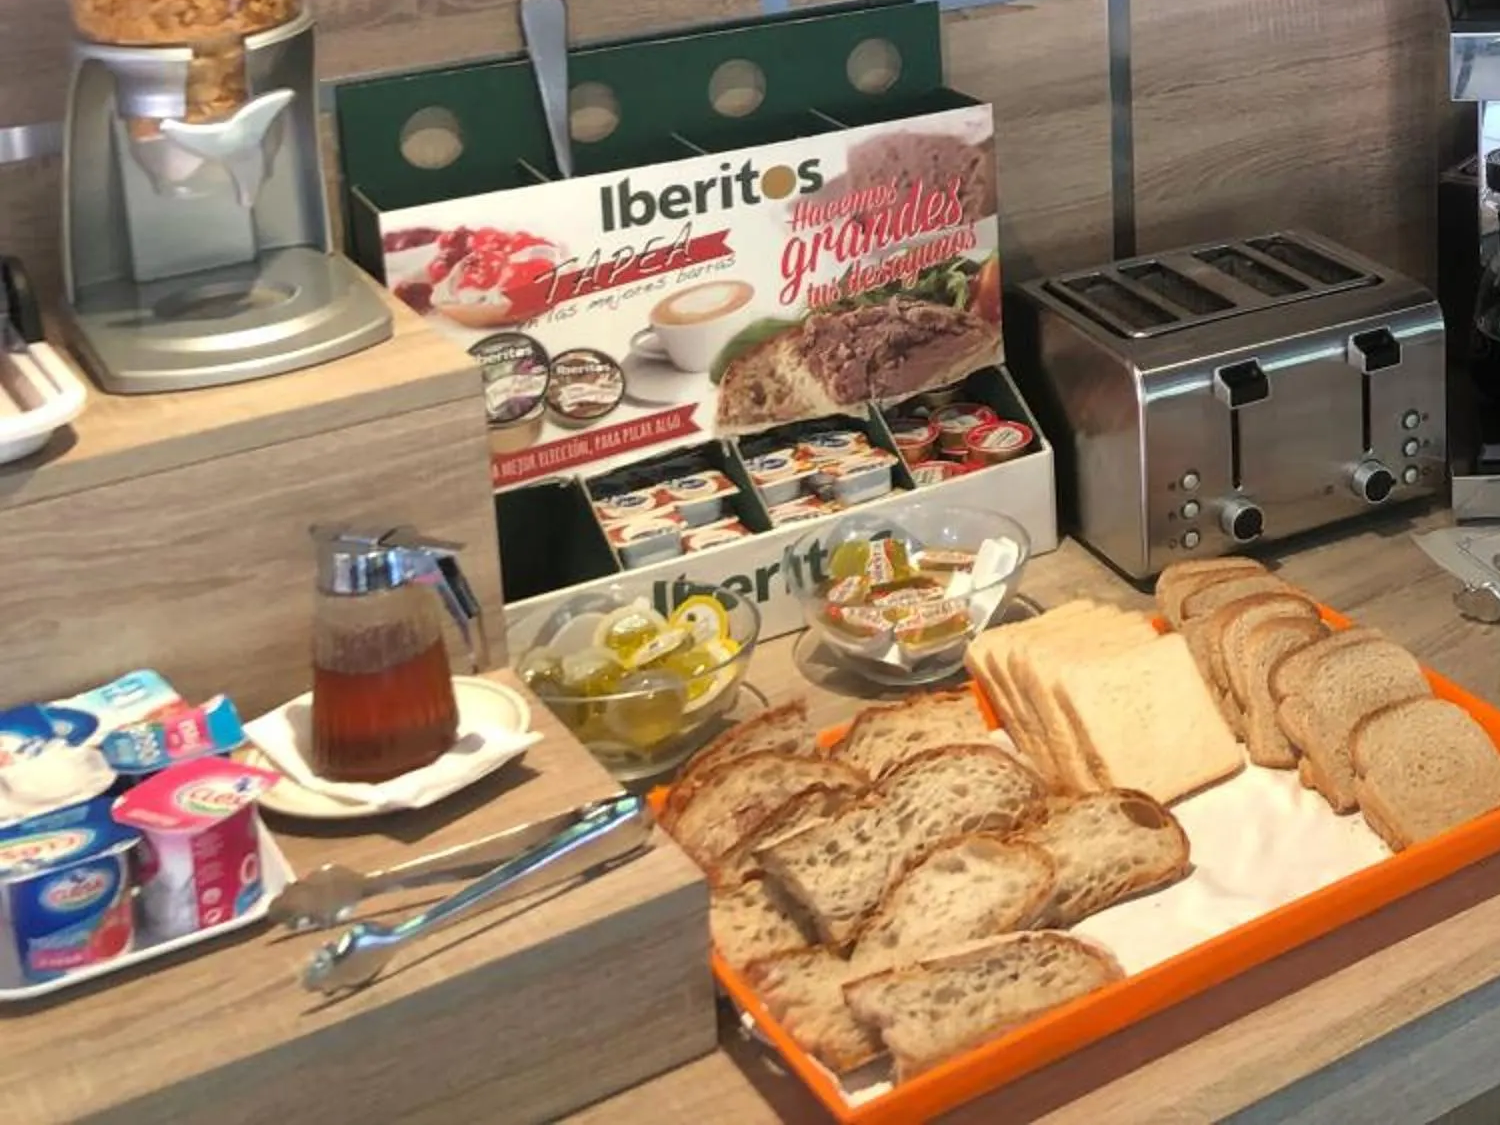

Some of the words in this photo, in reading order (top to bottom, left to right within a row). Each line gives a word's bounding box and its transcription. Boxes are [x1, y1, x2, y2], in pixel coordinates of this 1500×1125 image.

[600, 158, 824, 233] Iberitos
[786, 176, 898, 231] Hacemos
[534, 221, 693, 304] TAPEA
[779, 175, 963, 306] grandes
[807, 277, 840, 310] tus
[846, 226, 978, 296] desayunos
